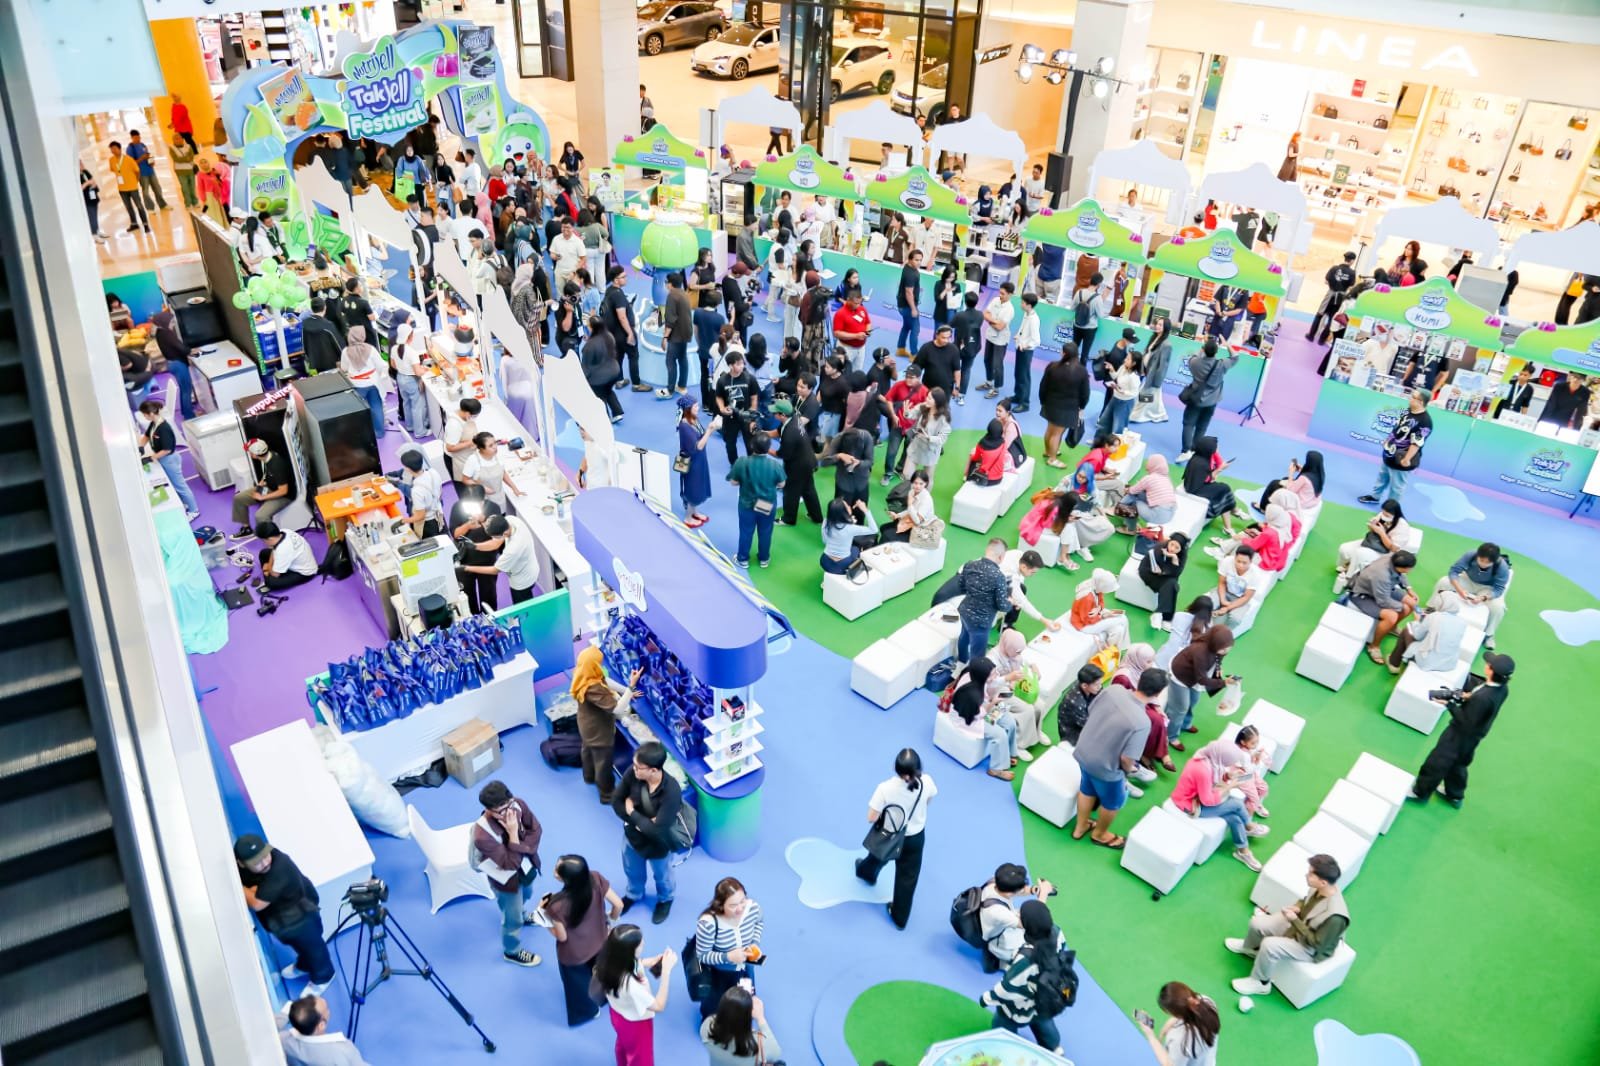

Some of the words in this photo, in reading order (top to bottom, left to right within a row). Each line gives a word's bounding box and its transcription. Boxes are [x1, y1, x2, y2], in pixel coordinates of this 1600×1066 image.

[352, 44, 394, 80] Nutrijell
[1251, 19, 1480, 78] LINEA
[349, 101, 426, 137] Festival
[1415, 313, 1441, 327] KUMI
